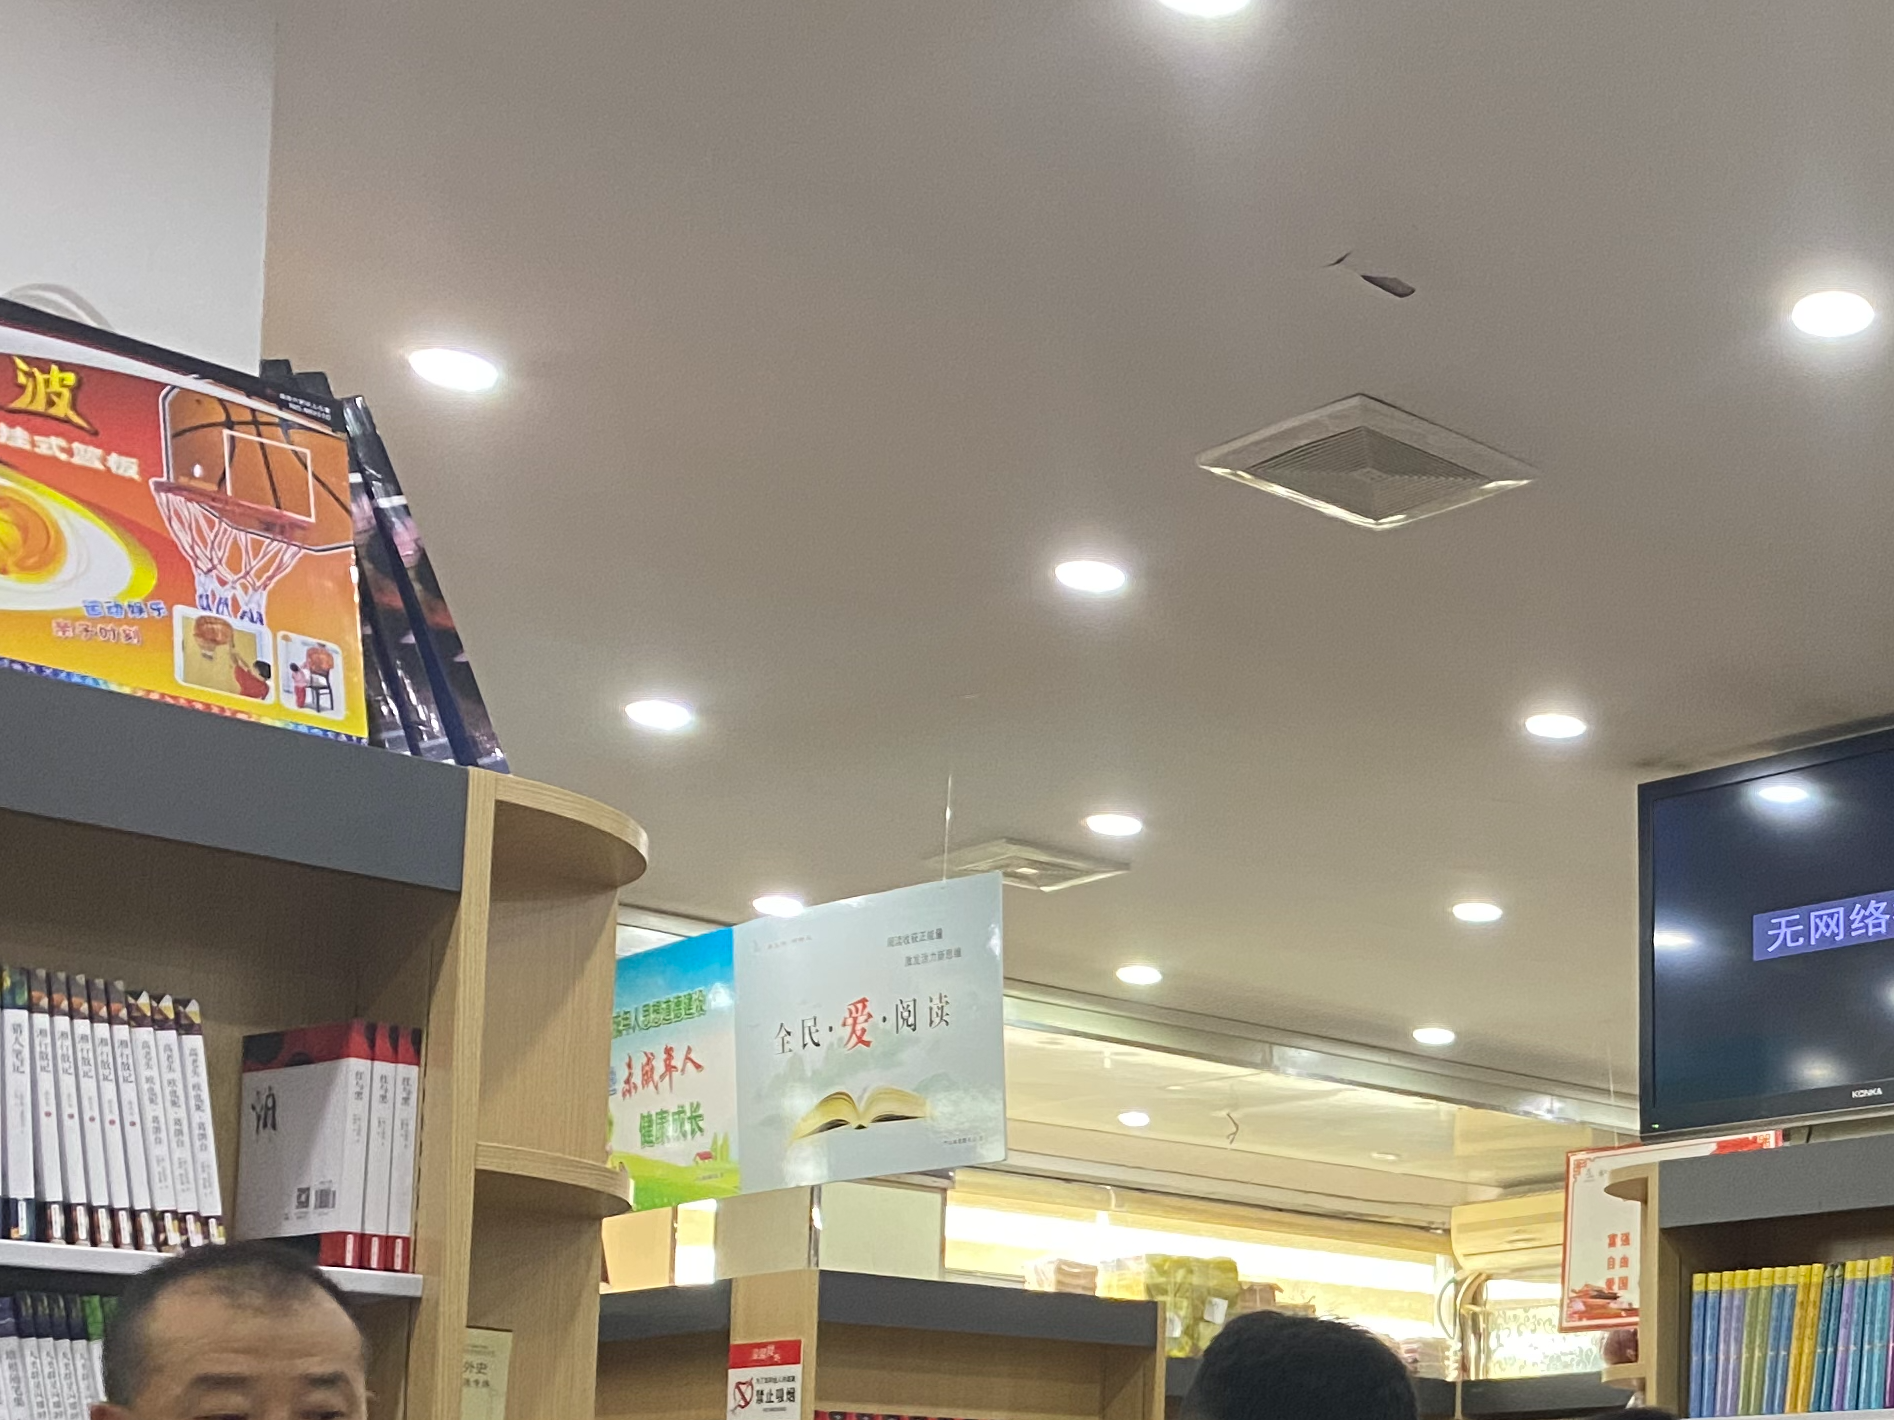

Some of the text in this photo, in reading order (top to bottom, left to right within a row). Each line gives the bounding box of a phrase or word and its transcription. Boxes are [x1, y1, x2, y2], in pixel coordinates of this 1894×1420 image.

[2, 355, 98, 435] 波
[52, 618, 142, 645] 亲子时刻
[12, 1023, 25, 1074] 猎人笔记
[37, 1028, 51, 1073] 湘行散记
[58, 1030, 72, 1075] 湘行散记
[78, 1034, 93, 1079] 湘行散记
[99, 1037, 113, 1082] 湘行散记
[118, 1039, 133, 1084] 湘行散记
[622, 1045, 704, 1101] 未成年人
[1852, 1087, 1883, 1099] KONKA
[640, 1101, 704, 1149] 健康成长
[1607, 1232, 1631, 1248] 富强
[1607, 1254, 1629, 1270] 自由
[756, 1387, 796, 1404] 禁止吸烟
